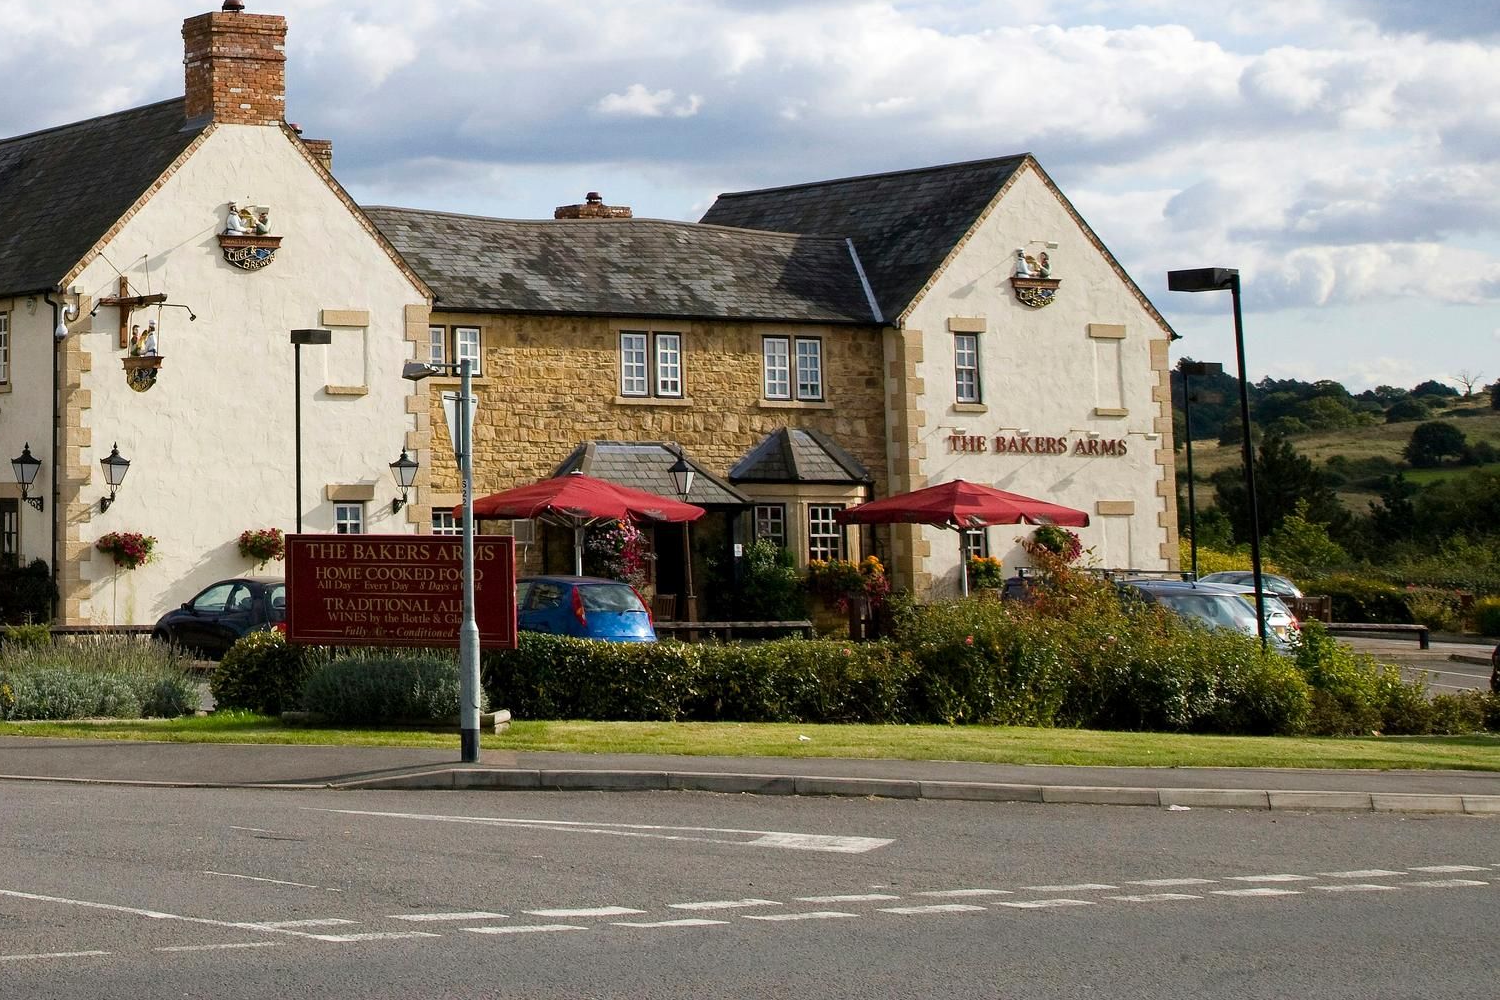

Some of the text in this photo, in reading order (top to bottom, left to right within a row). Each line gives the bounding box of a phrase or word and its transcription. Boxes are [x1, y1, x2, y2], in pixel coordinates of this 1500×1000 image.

[228, 249, 249, 261] CHEF
[243, 253, 276, 269] BREWER
[948, 435, 1128, 456] THE BAKERS ARMS
[306, 543, 348, 559] THE
[353, 544, 430, 560] BAKERS
[315, 566, 362, 580] HOME
[365, 567, 435, 581] COOKED
[317, 580, 332, 590] All
[334, 580, 352, 591] Day
[364, 581, 388, 591] Every
[391, 581, 409, 591] Day
[419, 582, 426, 590] 8
[428, 582, 450, 592] Days
[324, 598, 433, 612] TRADITIONAL
[328, 612, 367, 622] WINES
[370, 612, 380, 624] by
[384, 613, 399, 623] the
[402, 613, 431, 623] Bottle
[433, 613, 441, 623] &
[345, 626, 366, 637] Fully
[396, 627, 454, 638] Conditioned
